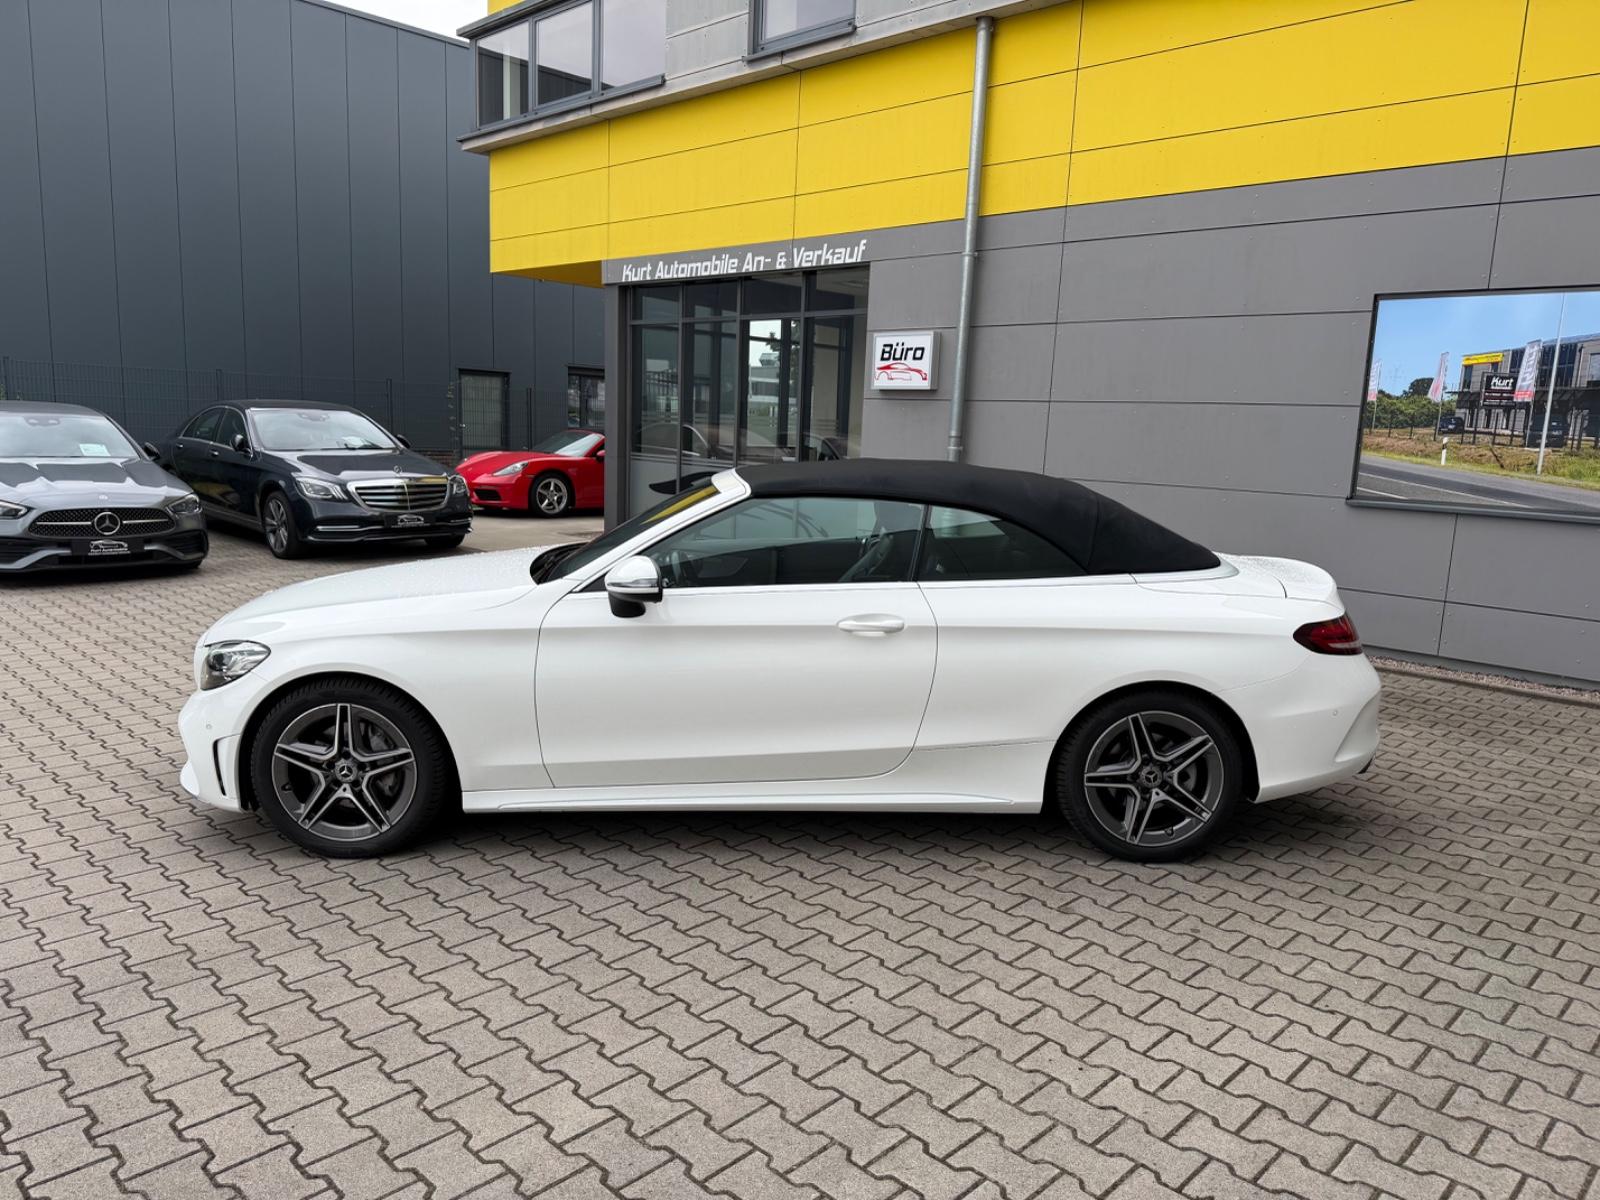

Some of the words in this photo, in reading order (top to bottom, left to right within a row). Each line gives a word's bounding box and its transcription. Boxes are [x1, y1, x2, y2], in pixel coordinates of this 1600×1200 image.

[622, 263, 651, 282] Kurt
[655, 253, 738, 279] Automobile
[742, 252, 771, 273] An-
[775, 252, 787, 269] &
[793, 239, 867, 268] Verkauf
[880, 341, 925, 361] Büro
[1490, 376, 1514, 387] Kurt
